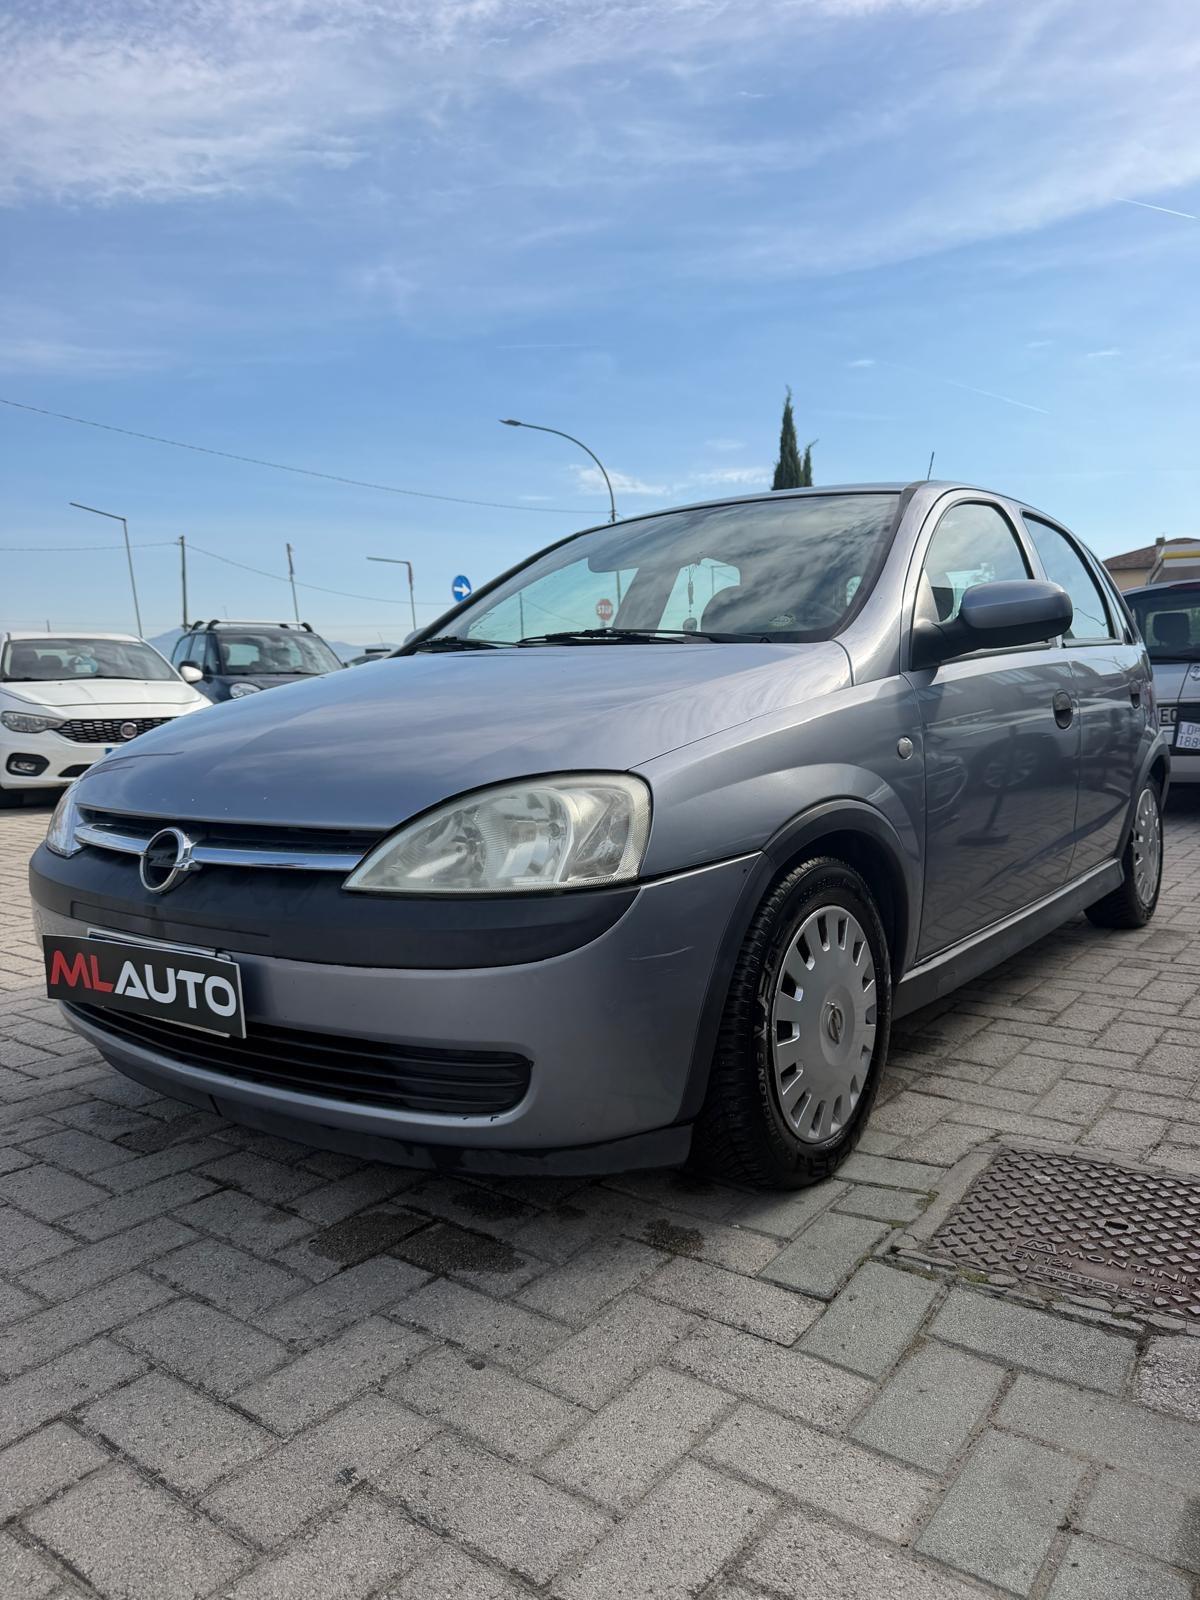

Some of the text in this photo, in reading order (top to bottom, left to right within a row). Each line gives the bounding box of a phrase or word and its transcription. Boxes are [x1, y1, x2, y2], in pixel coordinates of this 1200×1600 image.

[598, 604, 611, 614] STOP
[1012, 1249, 1039, 1262] EN
[1044, 1257, 1073, 1269] 124
[1152, 1282, 1183, 1296] 125
[1037, 1266, 1117, 1290] ERMETICO
[1060, 1248, 1188, 1284] MONTINI
